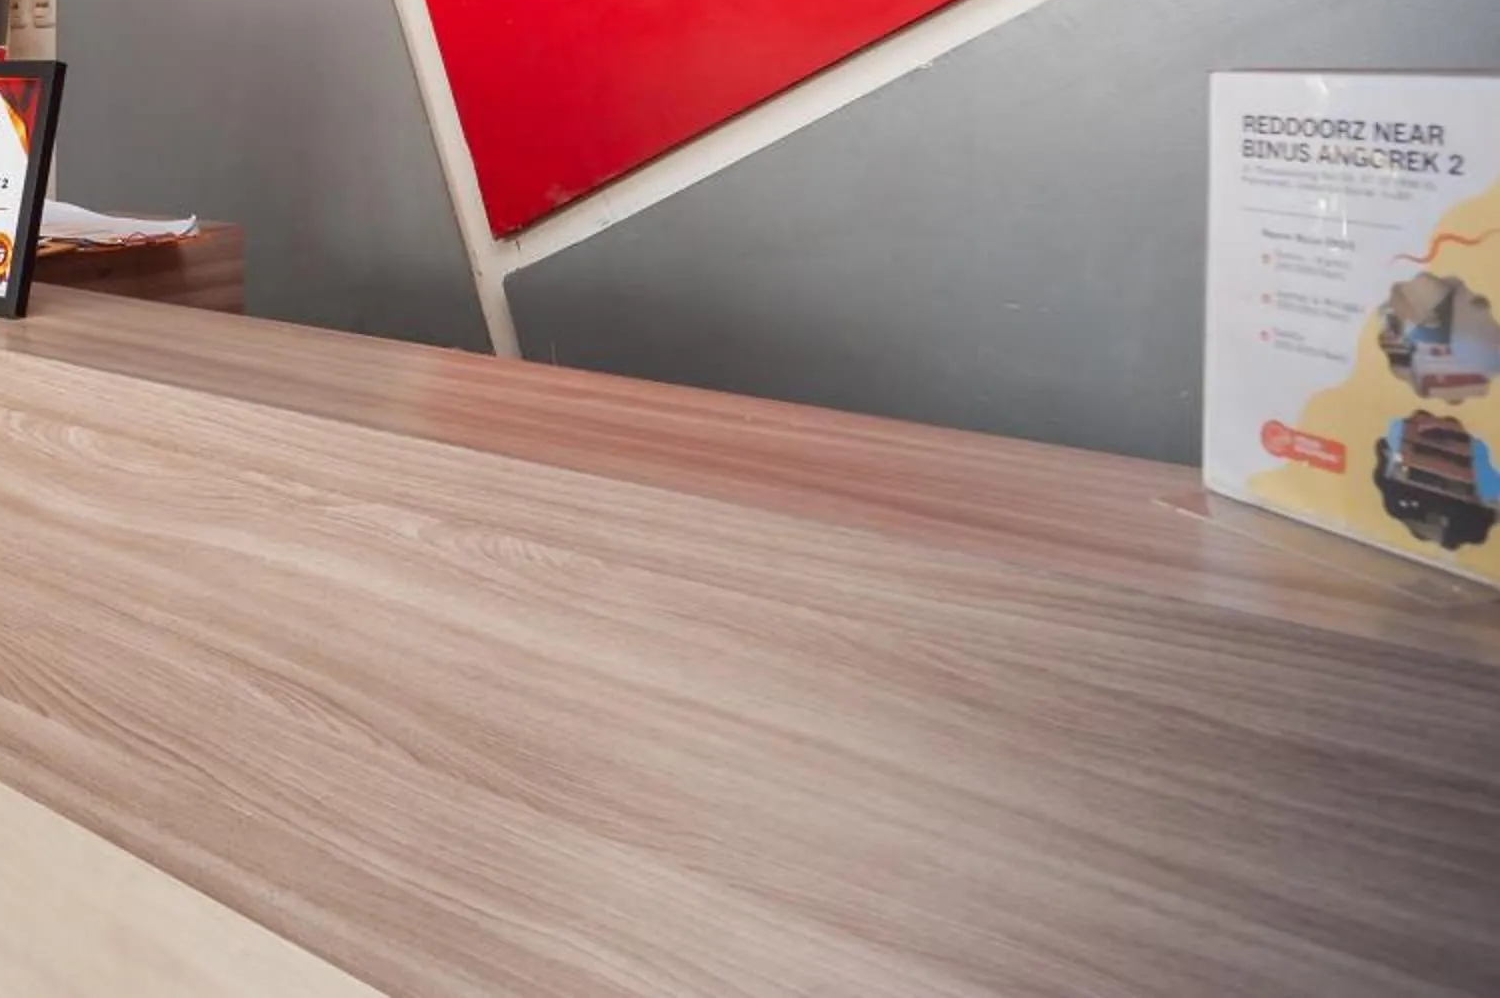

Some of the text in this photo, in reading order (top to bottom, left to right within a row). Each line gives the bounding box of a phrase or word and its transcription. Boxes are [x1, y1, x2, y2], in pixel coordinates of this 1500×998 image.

[1242, 114, 1446, 146] REDDOORZ NEAR
[1241, 138, 1312, 163] BINUS
[1447, 153, 1465, 176] 2
[1, 177, 10, 190] 2
